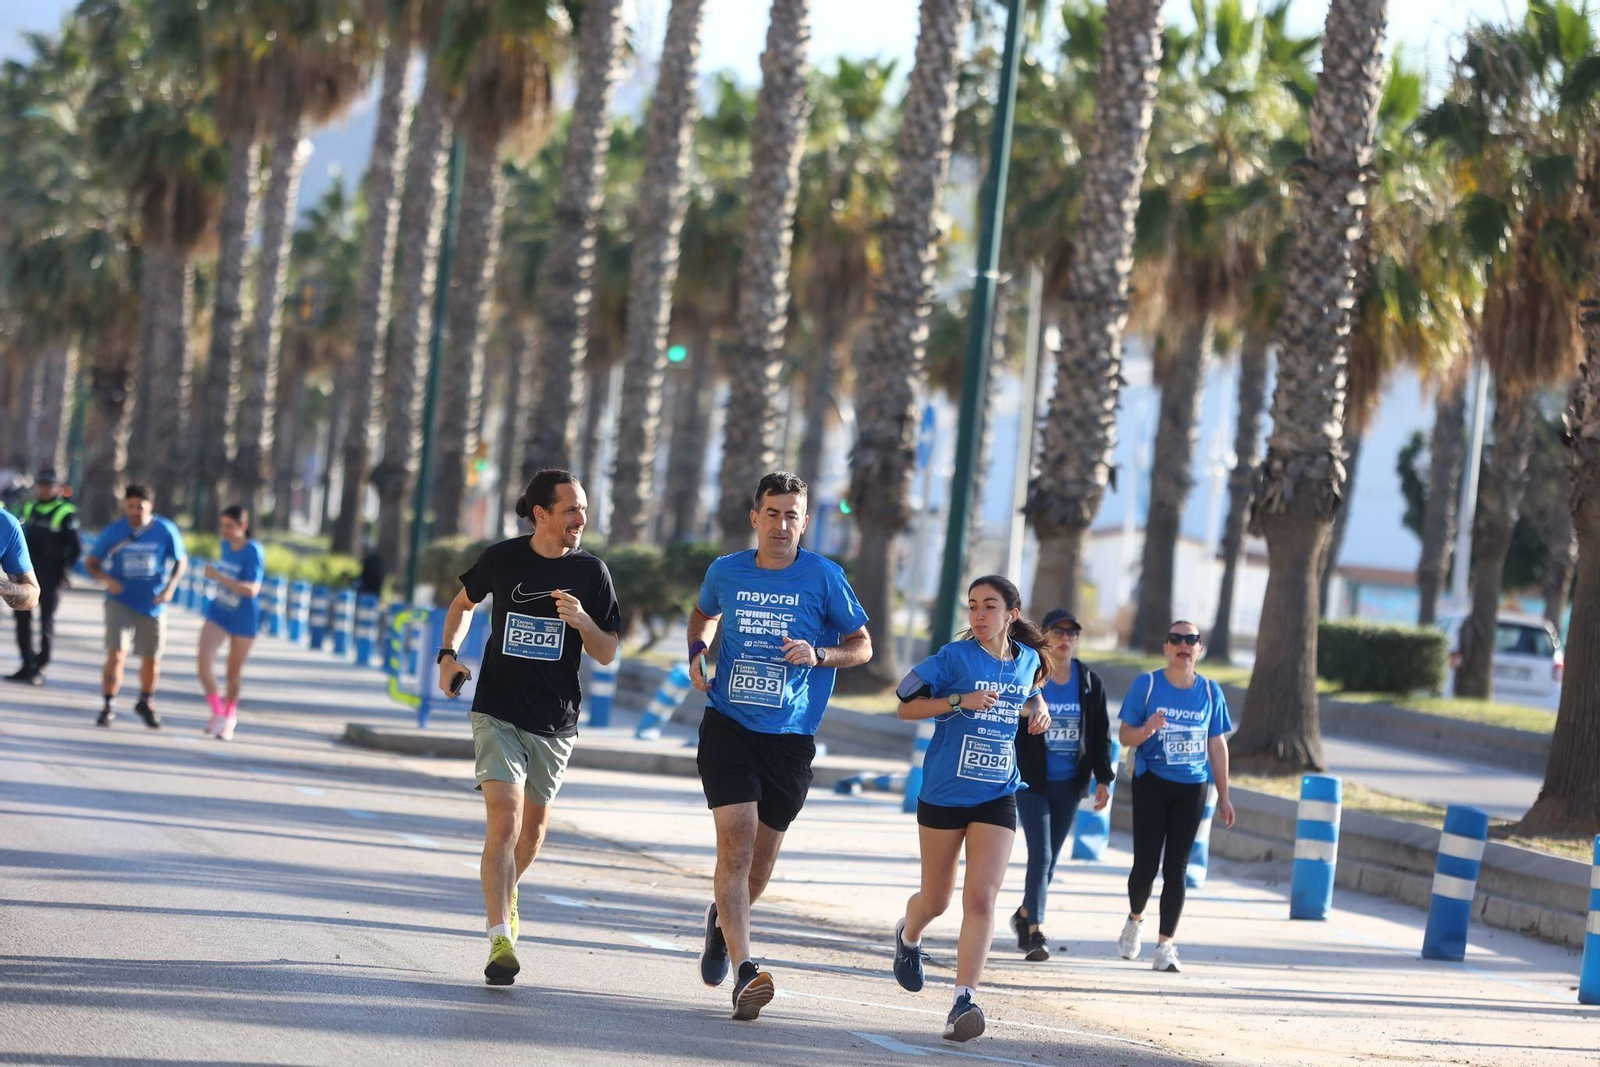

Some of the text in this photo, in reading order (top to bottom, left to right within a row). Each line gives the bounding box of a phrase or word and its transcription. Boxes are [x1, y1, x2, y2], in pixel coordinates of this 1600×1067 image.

[736, 590, 800, 606] mayoral
[735, 608, 794, 622] RUNNING
[740, 617, 788, 629] MAKES
[739, 625, 789, 637] FRIENDS
[511, 630, 556, 647] 2204
[734, 675, 778, 692] 2093
[1049, 703, 1081, 714] ayora
[1169, 742, 1201, 753] 2031
[967, 752, 1008, 769] 2094
